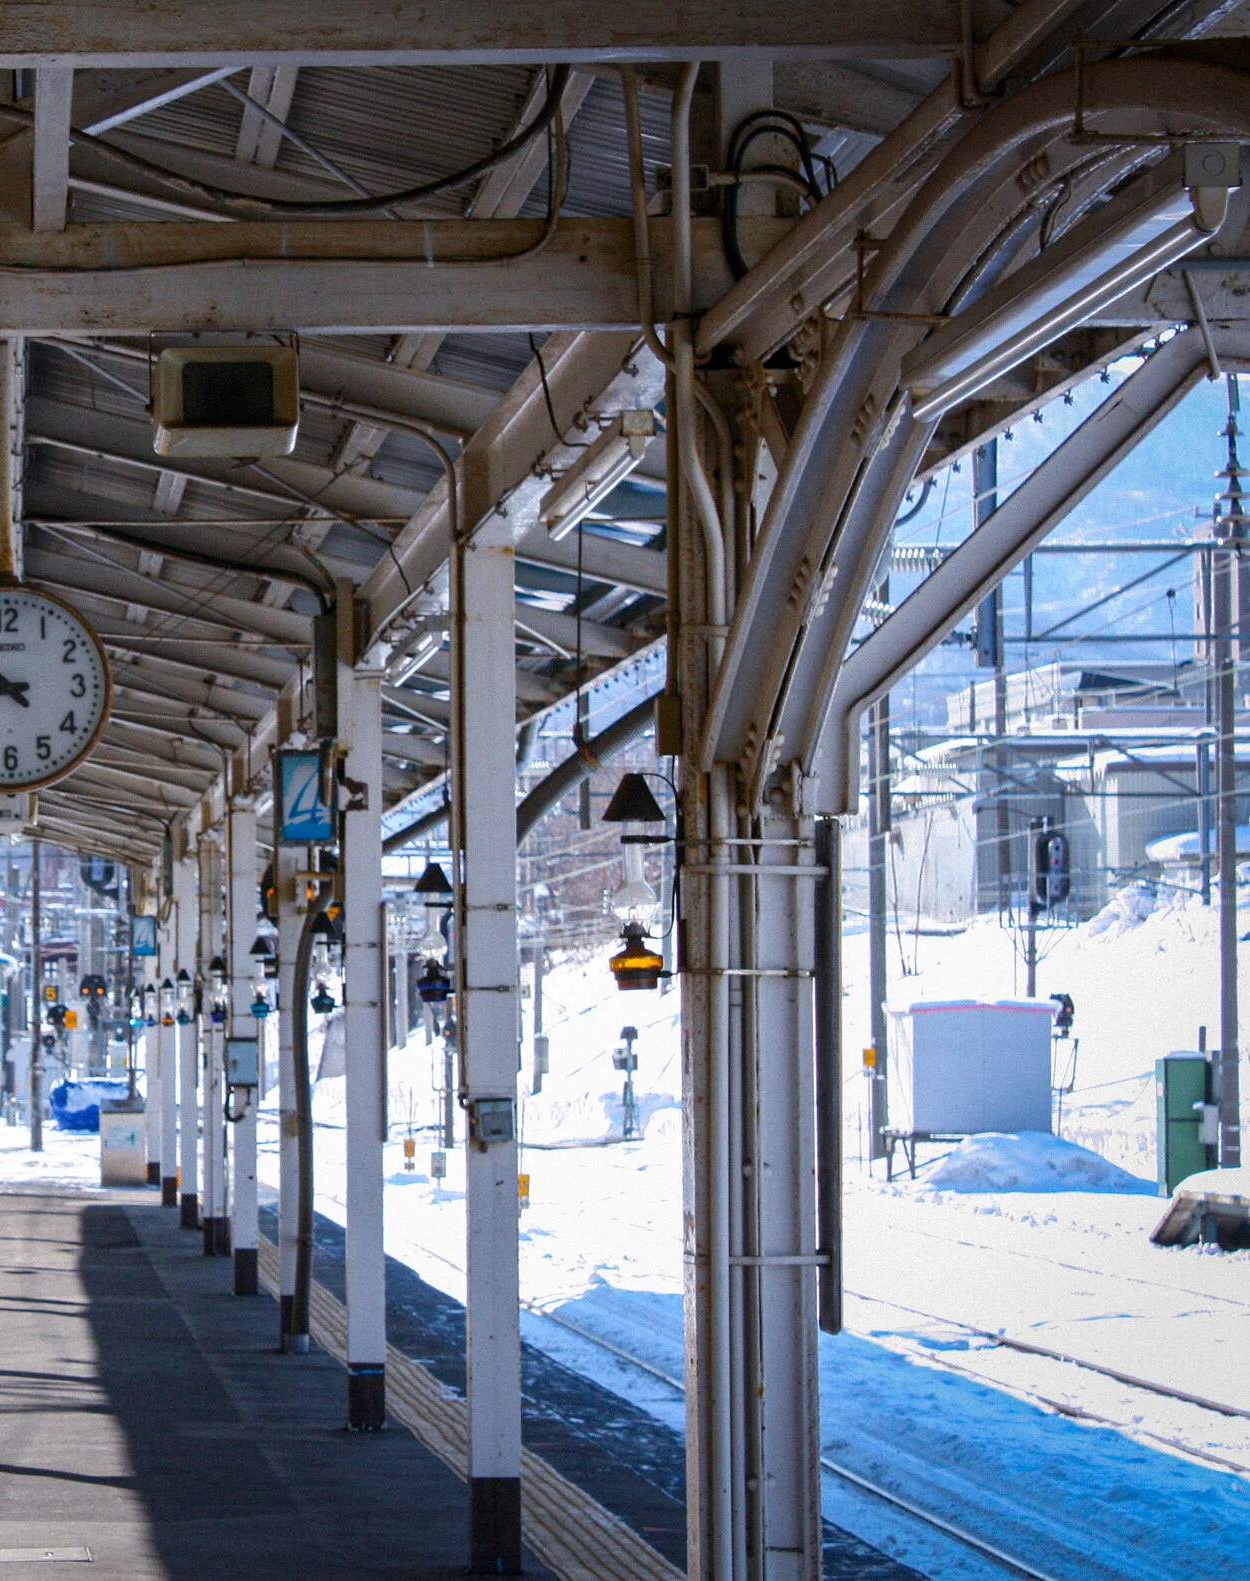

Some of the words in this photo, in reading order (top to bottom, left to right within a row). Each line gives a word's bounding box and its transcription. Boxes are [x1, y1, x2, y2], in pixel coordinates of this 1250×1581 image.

[40, 616, 46, 639] 1
[62, 639, 76, 663] 2
[70, 674, 86, 697] 3
[59, 711, 77, 735] 4
[4, 746, 18, 770] 6
[36, 736, 51, 760] 5
[289, 766, 326, 823] 4
